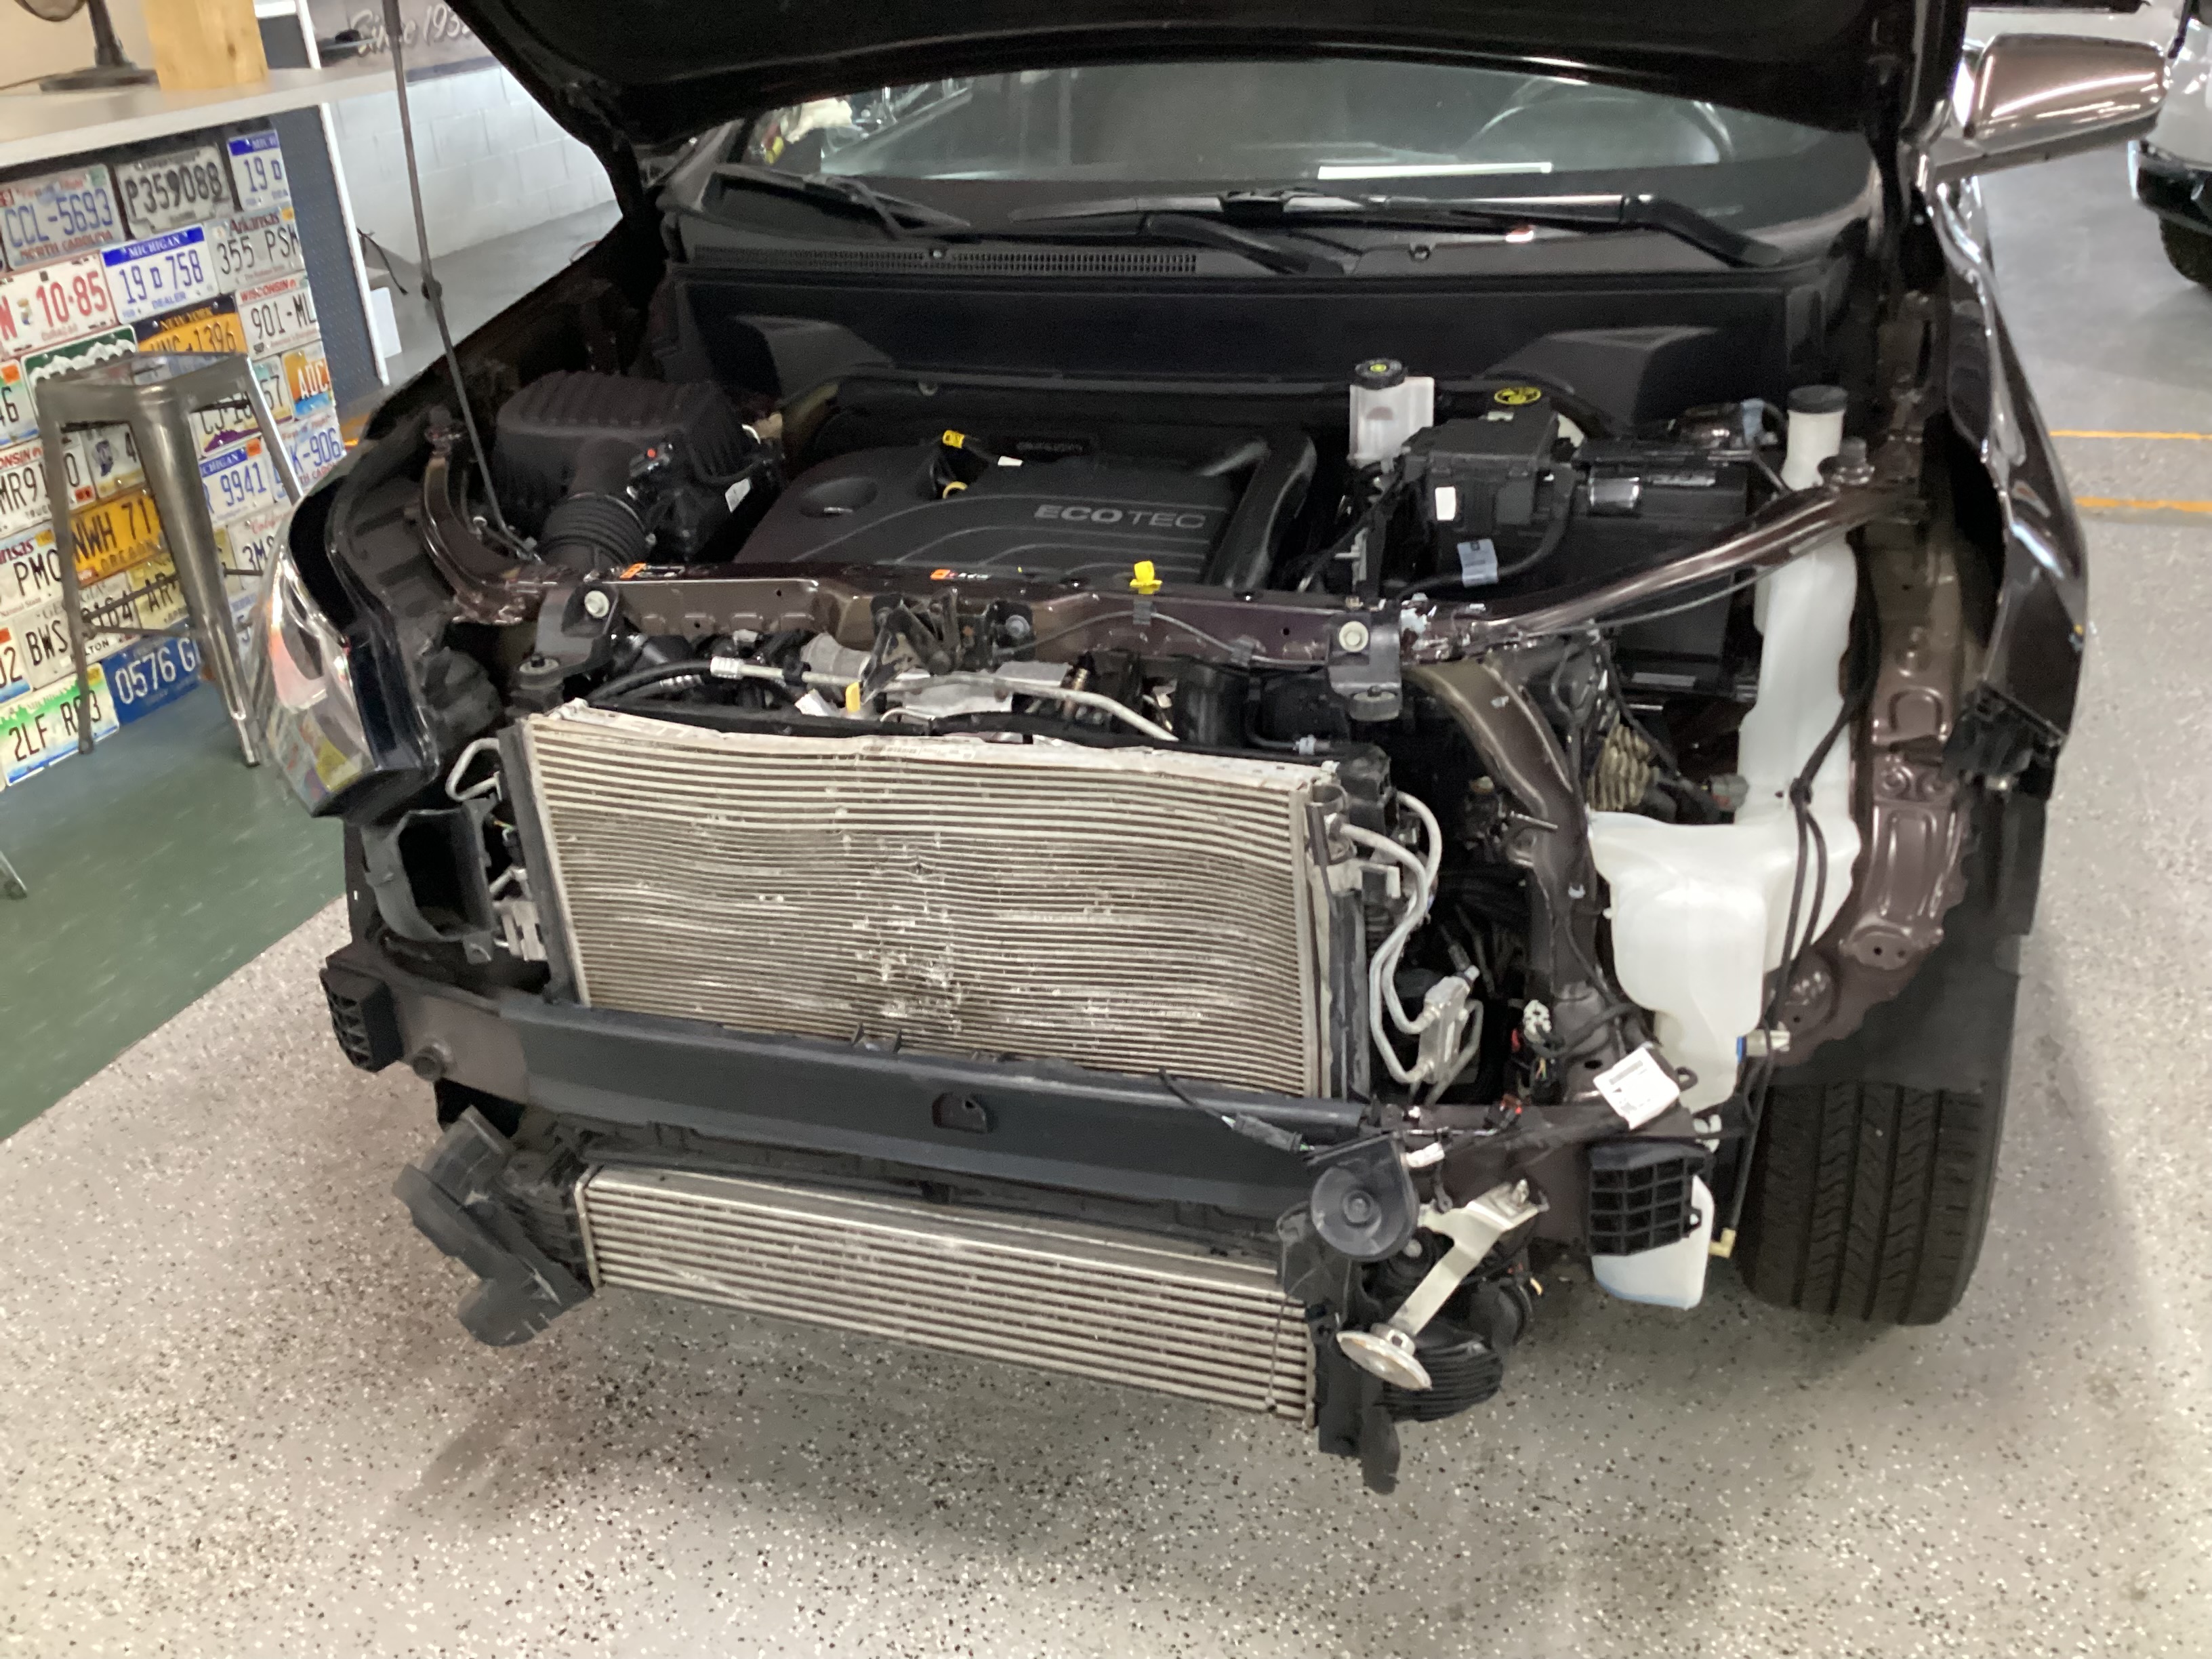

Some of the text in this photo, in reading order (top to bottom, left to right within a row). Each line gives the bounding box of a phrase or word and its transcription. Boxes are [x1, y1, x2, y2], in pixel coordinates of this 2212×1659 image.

[243, 156, 268, 192] 19
[230, 211, 280, 236] Arkansas
[20, 230, 113, 260] NORTH CAROLINA
[127, 234, 181, 258] MICHIGAN
[216, 234, 255, 275] 355
[119, 264, 148, 304] 19
[165, 249, 204, 291] 758
[240, 279, 289, 302] WISCONSIN
[151, 291, 187, 310] DEALER
[220, 462, 267, 508] 9941
[1033, 504, 1206, 529] ECOTEC
[25, 619, 68, 667] BWS
[115, 646, 177, 705] 0576
[8, 712, 47, 762] 2LF
